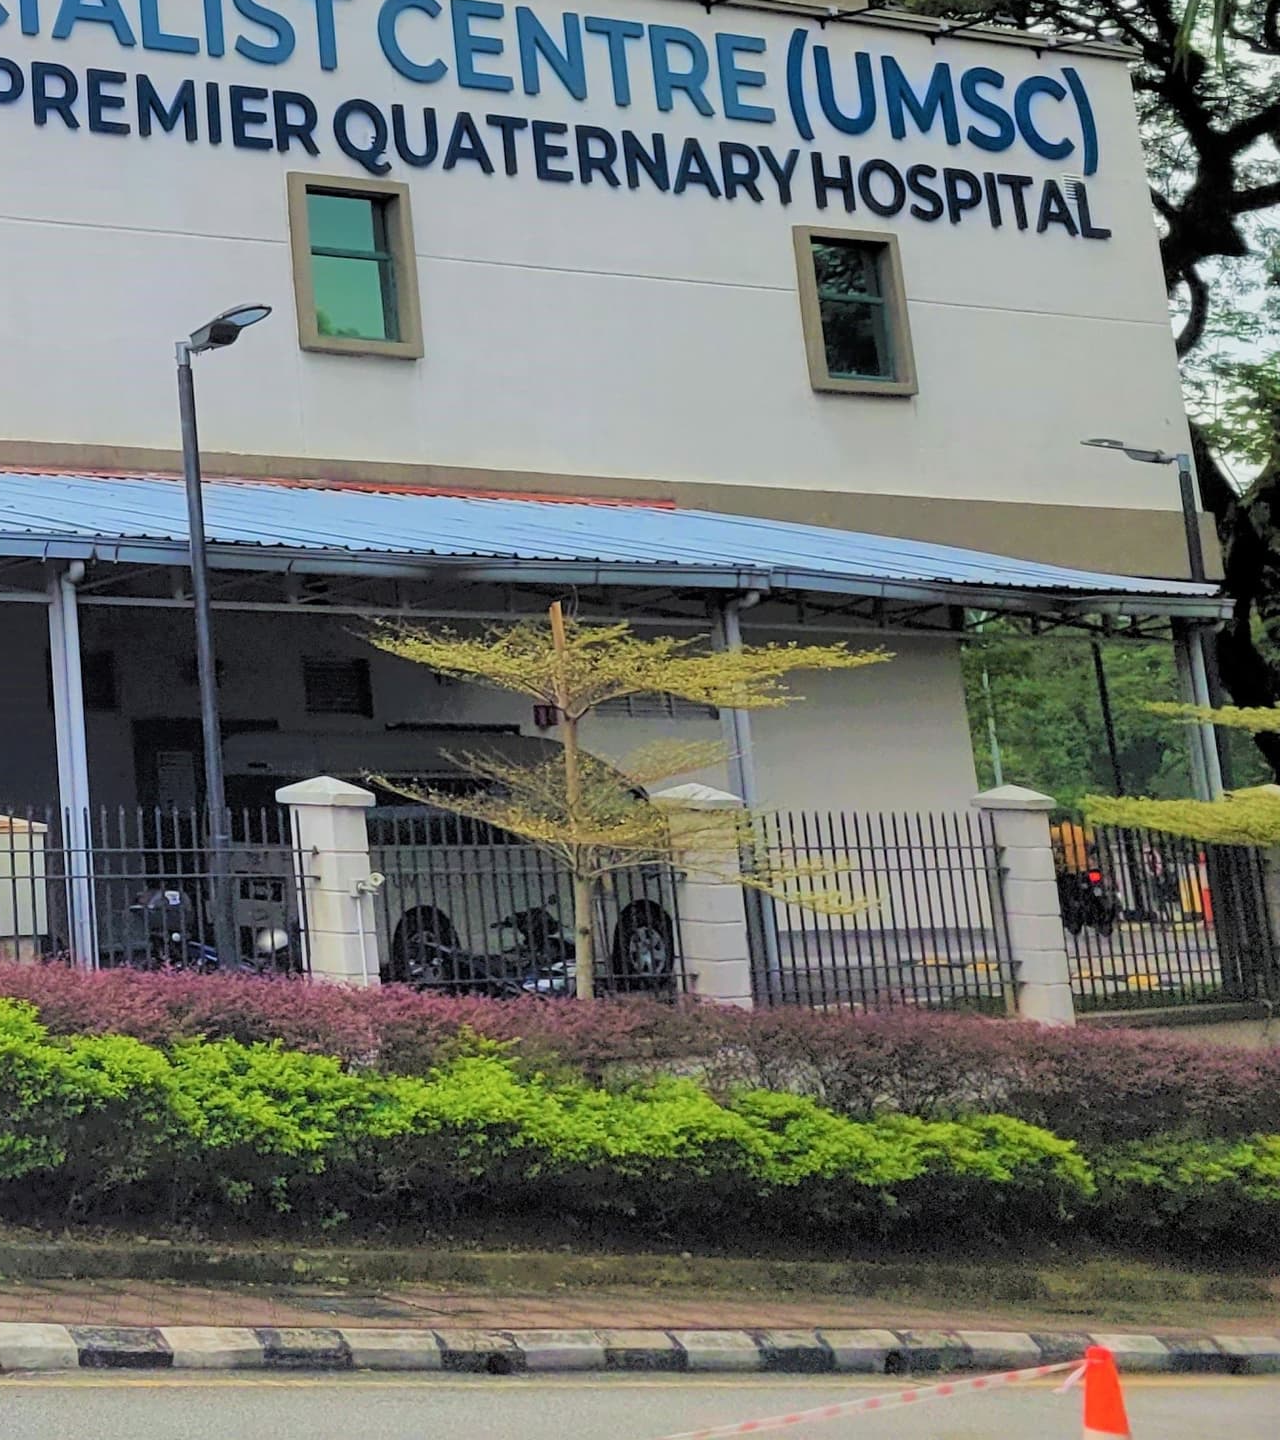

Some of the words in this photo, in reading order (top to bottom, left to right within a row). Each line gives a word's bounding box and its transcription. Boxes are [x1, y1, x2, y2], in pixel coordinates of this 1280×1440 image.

[333, 98, 800, 206] QUATERNARY
[811, 150, 1112, 240] HOSPITAL
[786, 28, 1099, 176] (UMSC)
